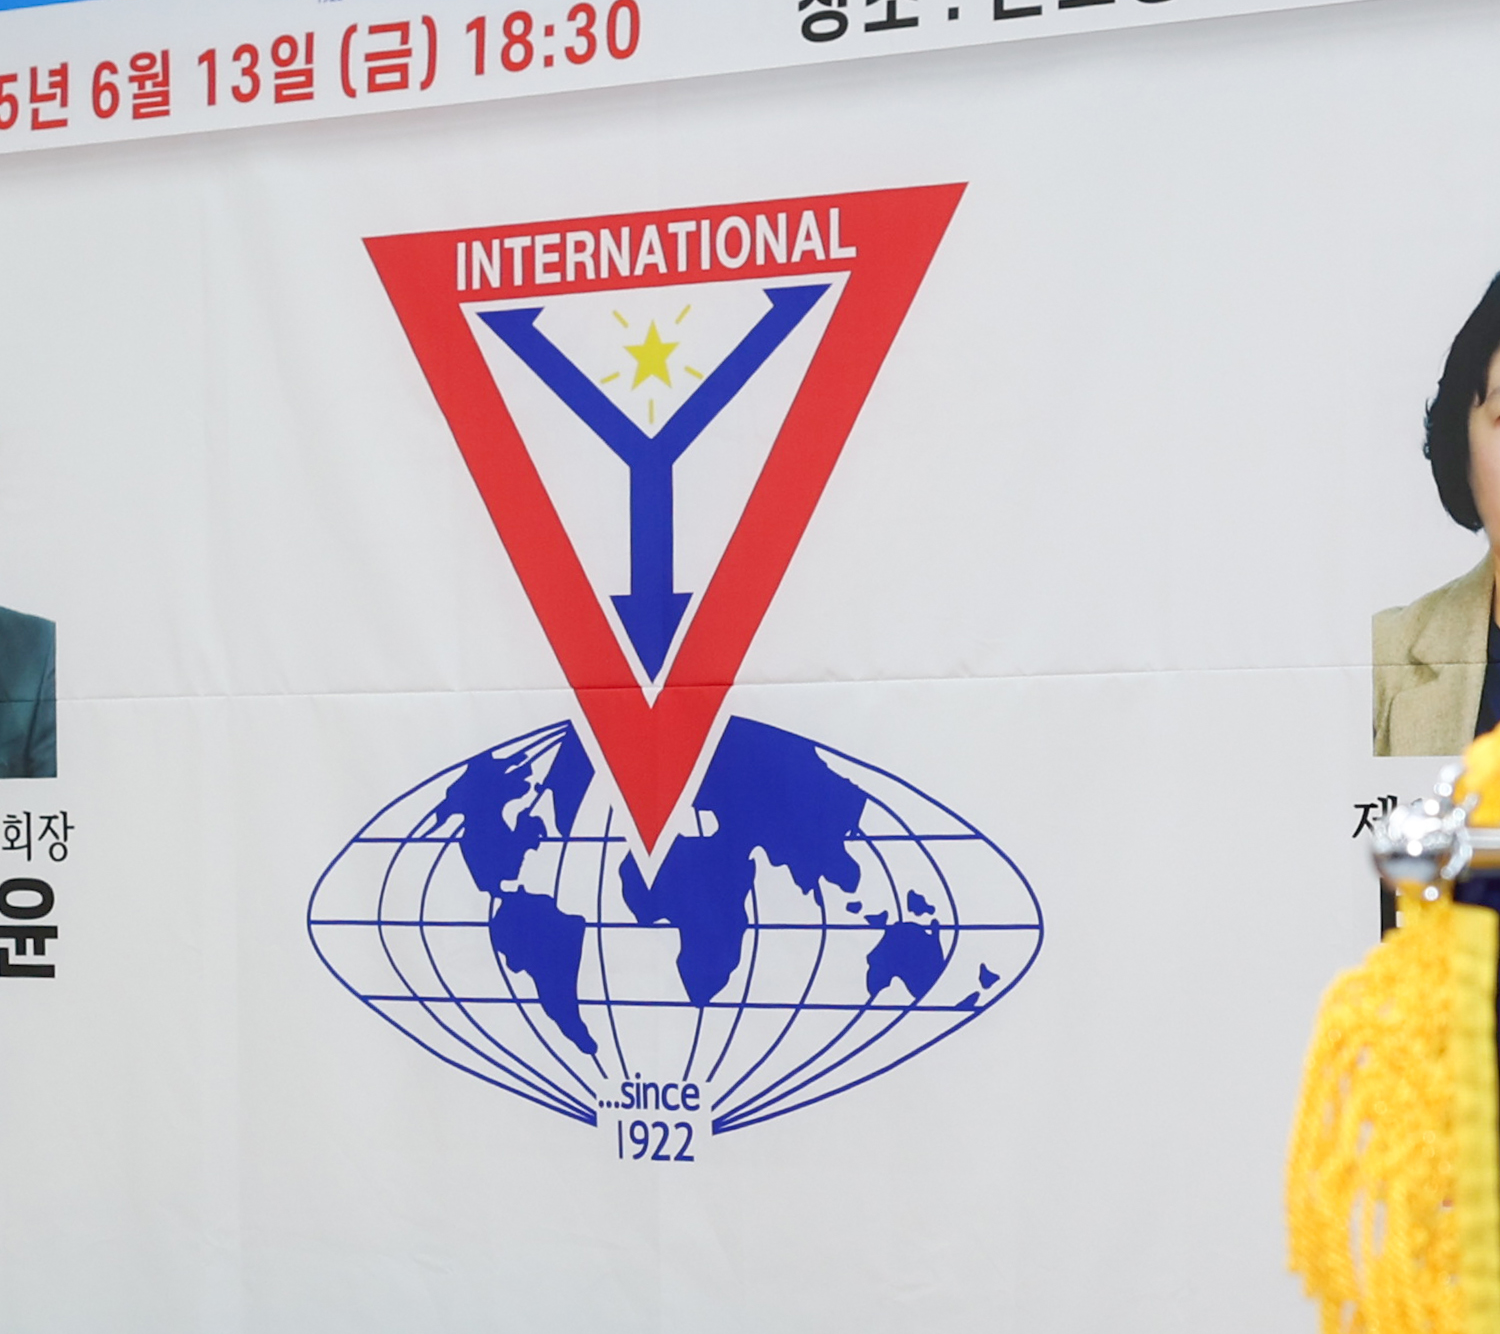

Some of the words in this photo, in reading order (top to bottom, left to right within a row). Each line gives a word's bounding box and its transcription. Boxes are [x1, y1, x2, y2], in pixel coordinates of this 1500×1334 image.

[92, 50, 171, 120] 6월
[199, 32, 315, 106] 13일
[341, 15, 437, 98] (금)
[455, 207, 858, 292] INTERNATIONAL
[617, 1119, 695, 1162] 1922
